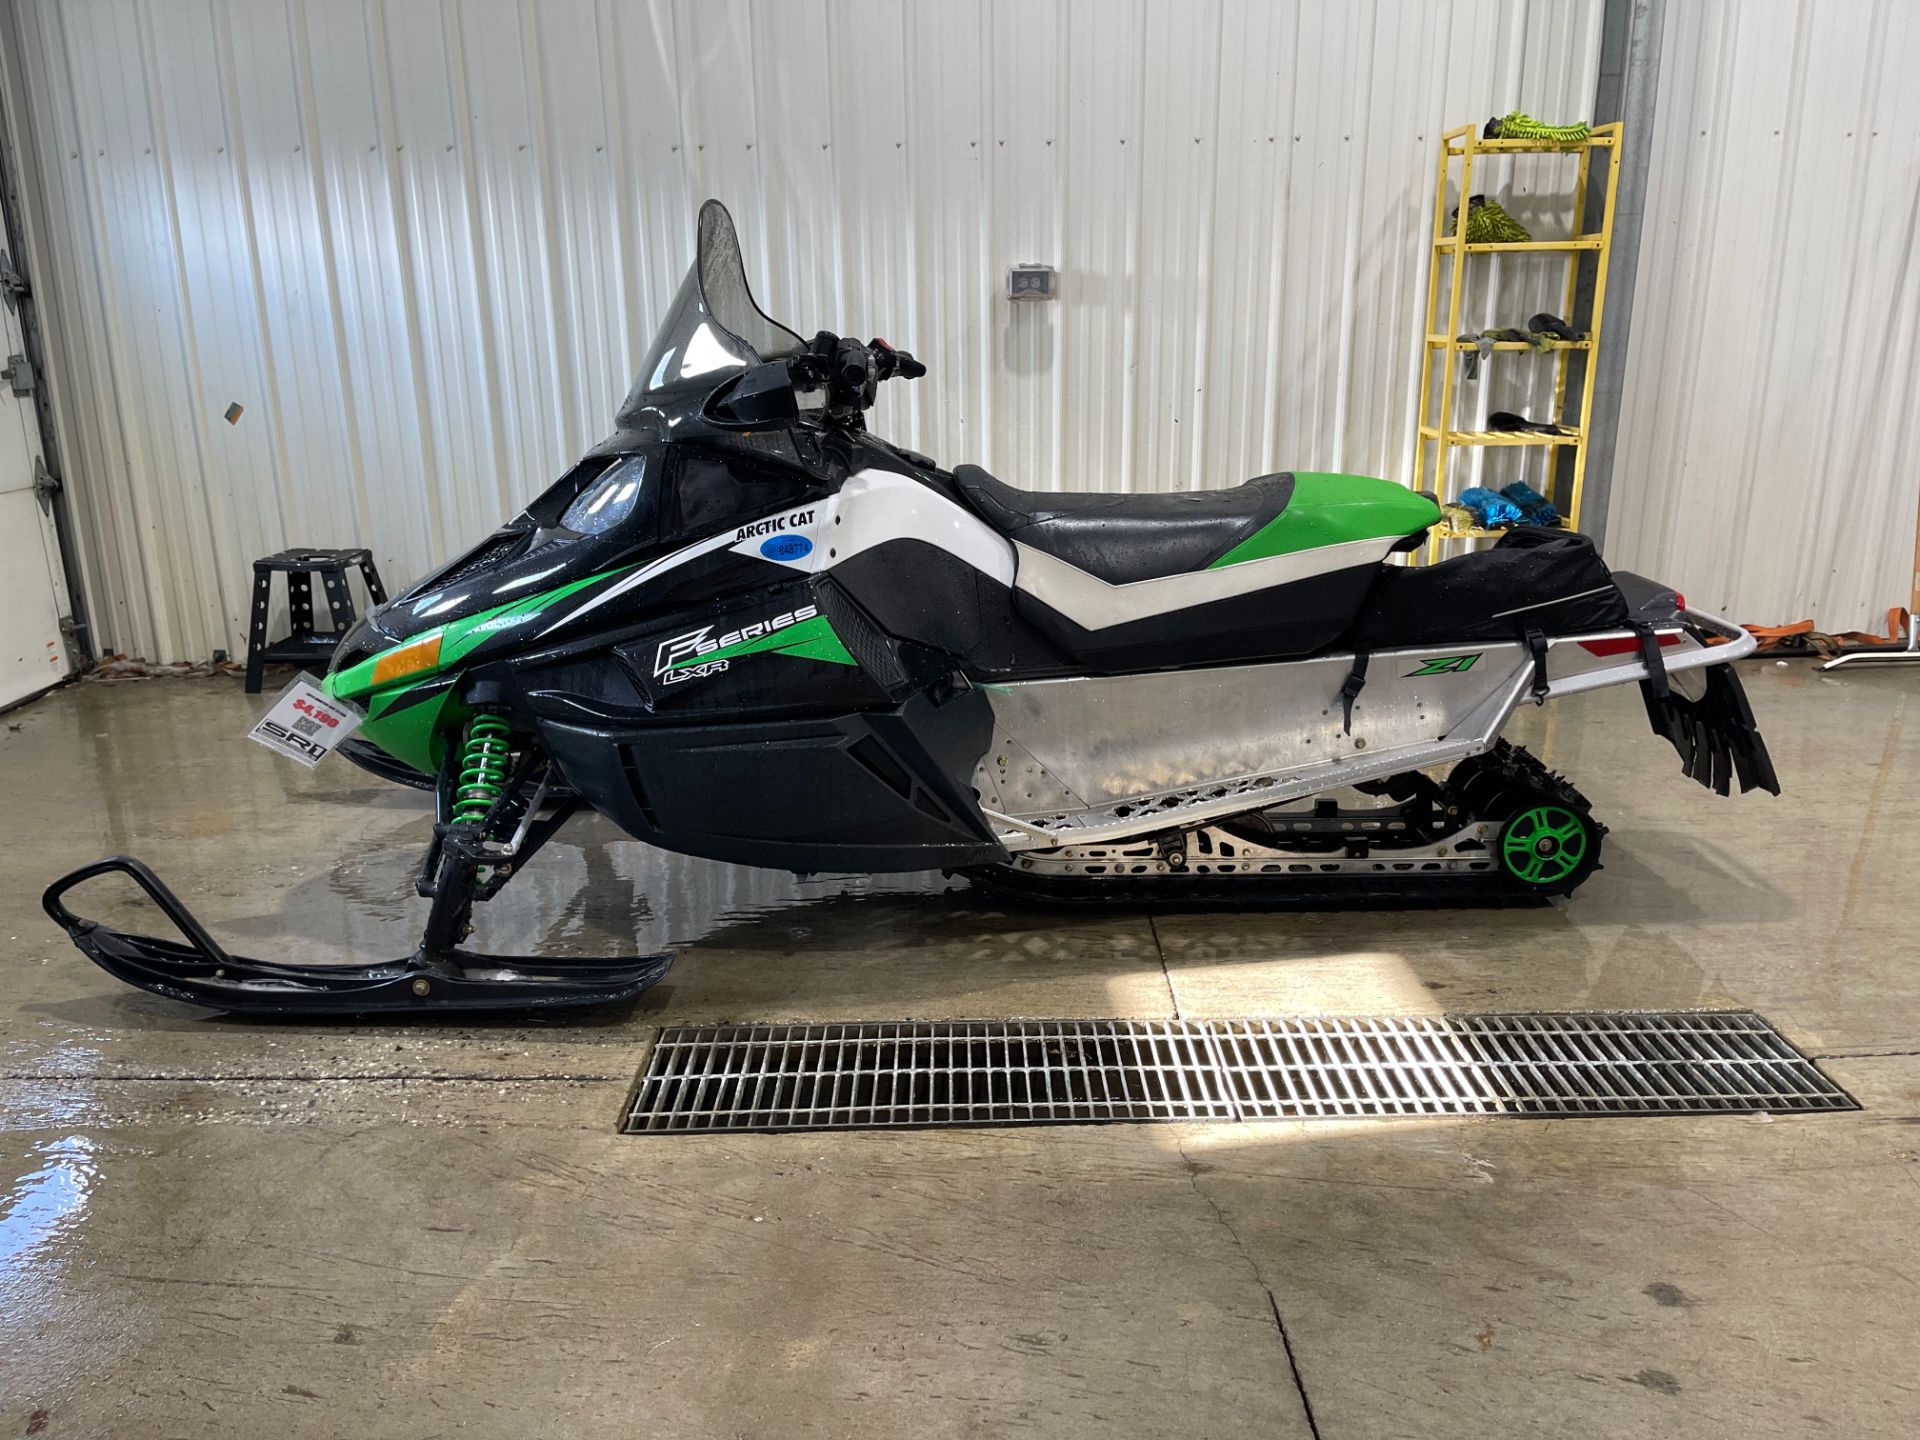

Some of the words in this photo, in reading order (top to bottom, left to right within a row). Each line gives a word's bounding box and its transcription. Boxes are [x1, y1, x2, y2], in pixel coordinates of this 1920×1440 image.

[735, 516, 786, 542] ARCTIC
[789, 510, 815, 528] CAT
[695, 604, 818, 656] SERIES
[663, 659, 730, 685] LXR
[1400, 652, 1484, 678] Z1
